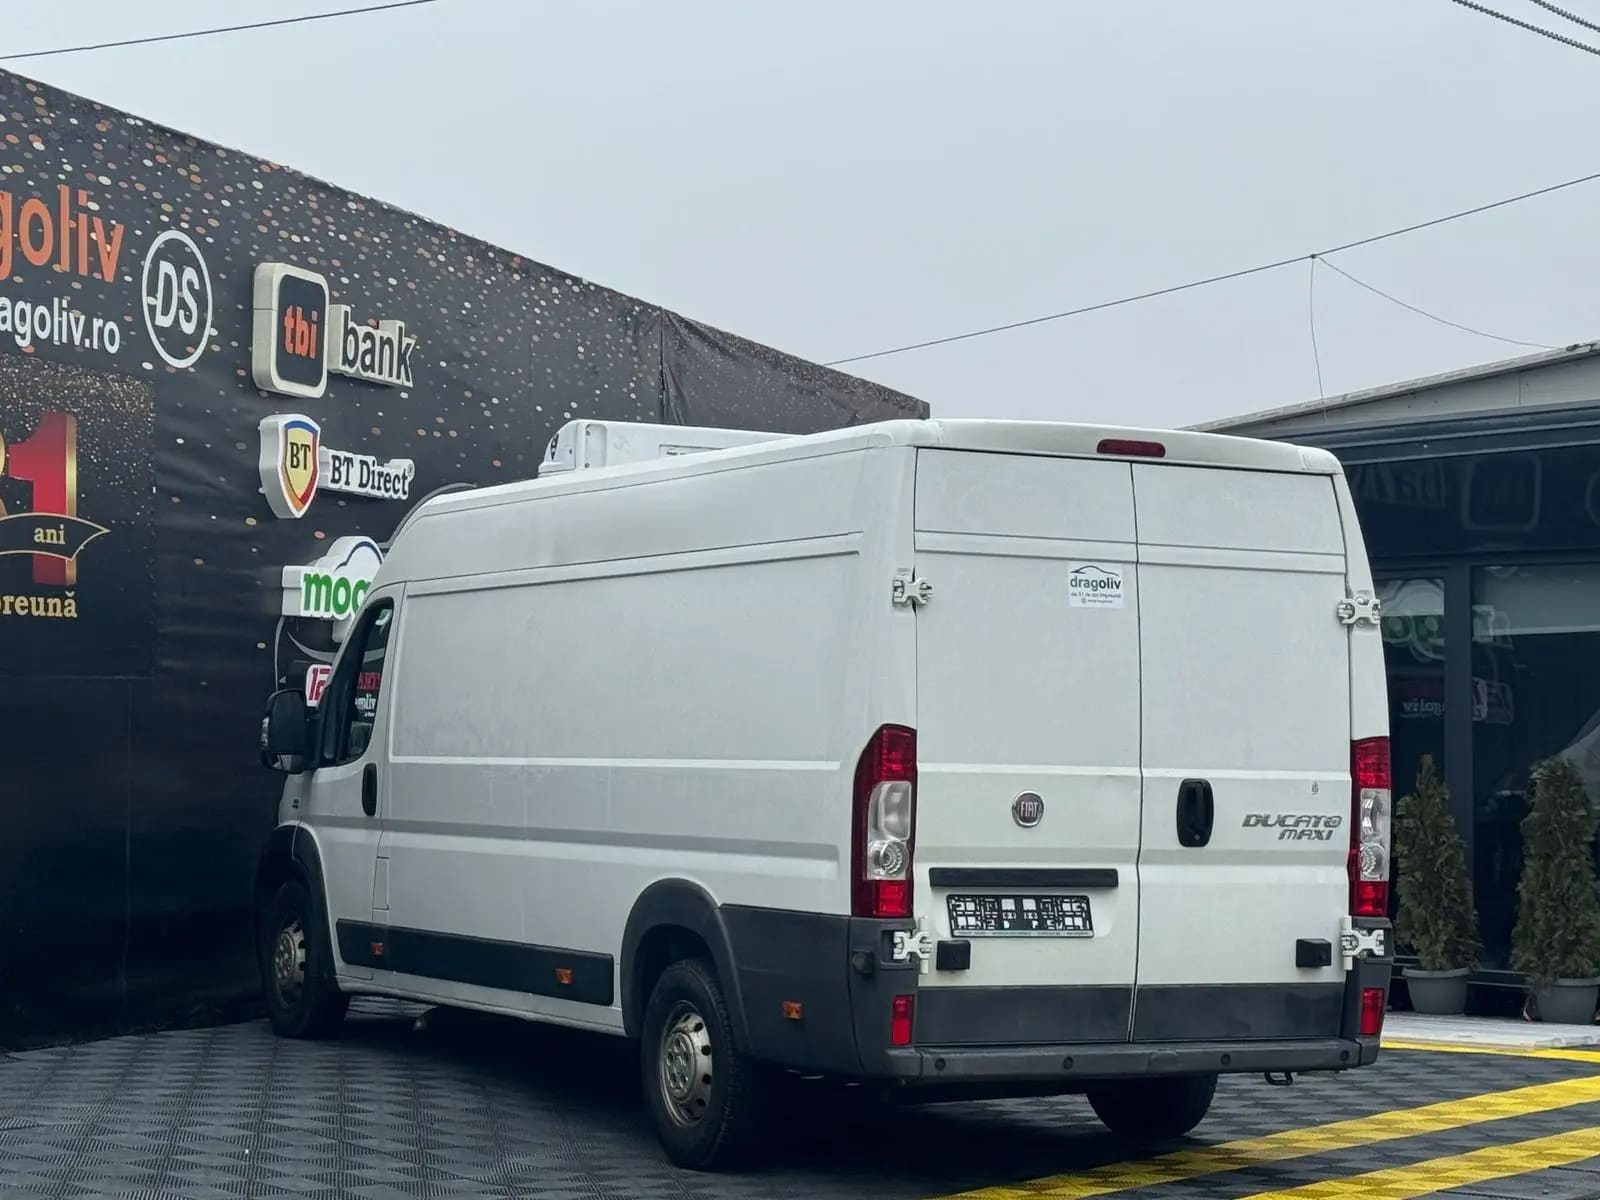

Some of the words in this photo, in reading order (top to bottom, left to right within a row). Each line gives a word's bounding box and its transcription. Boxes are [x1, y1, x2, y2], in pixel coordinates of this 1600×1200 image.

[155, 260, 200, 336] DS
[283, 304, 319, 360] tbi
[341, 309, 416, 386] bank
[288, 441, 311, 470] BT
[330, 454, 354, 486] BT
[358, 459, 408, 496] Direct
[33, 525, 67, 546] ani
[1070, 576, 1122, 592] dragoliv
[0, 590, 78, 618] reună
[1020, 801, 1039, 818] FIAT
[1242, 813, 1342, 828] DUCATO
[1278, 829, 1334, 841] MAXI
